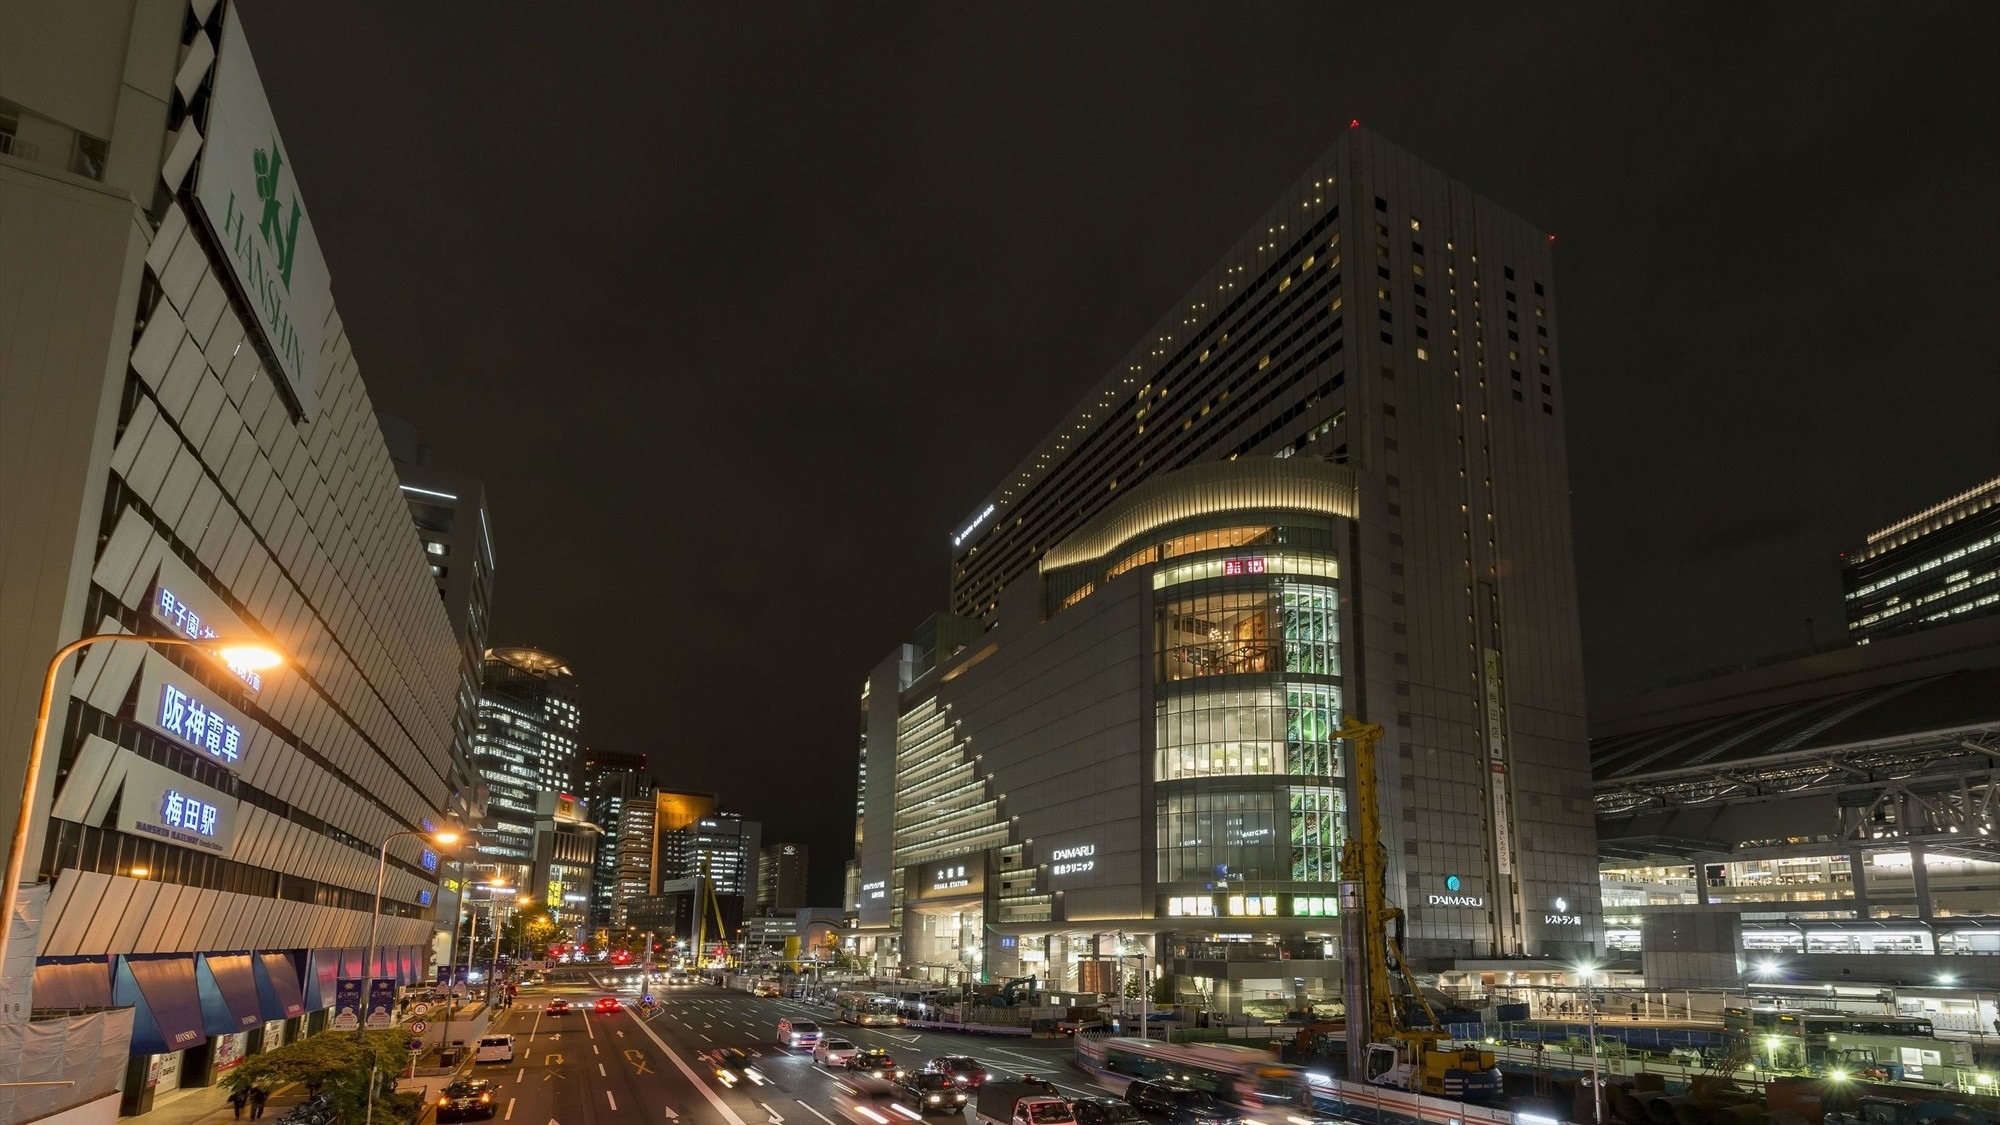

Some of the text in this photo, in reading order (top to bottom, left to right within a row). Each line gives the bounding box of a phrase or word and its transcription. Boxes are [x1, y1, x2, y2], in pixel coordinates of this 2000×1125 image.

[224, 188, 304, 381] HANSHIN
[162, 684, 240, 762] 阪神電車
[165, 790, 217, 836] 梅田駅
[1053, 844, 1095, 861] DAIMARU
[1429, 895, 1483, 907] DAIMARU
